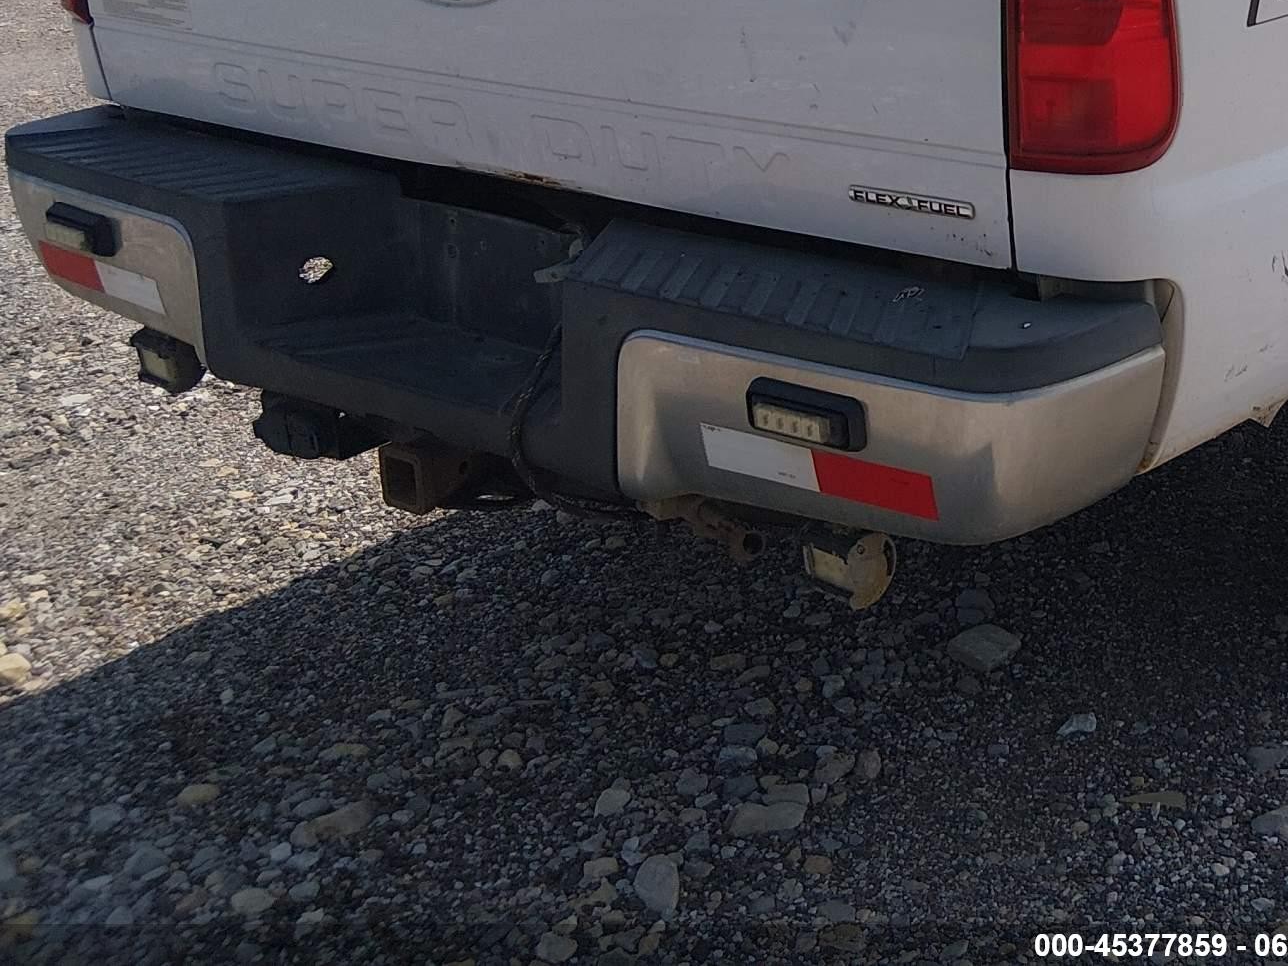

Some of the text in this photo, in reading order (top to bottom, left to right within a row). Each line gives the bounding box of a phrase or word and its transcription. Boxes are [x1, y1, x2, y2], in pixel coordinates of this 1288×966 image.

[212, 60, 791, 196] SUPER DUTY
[852, 188, 974, 218] FLEX FUEL
